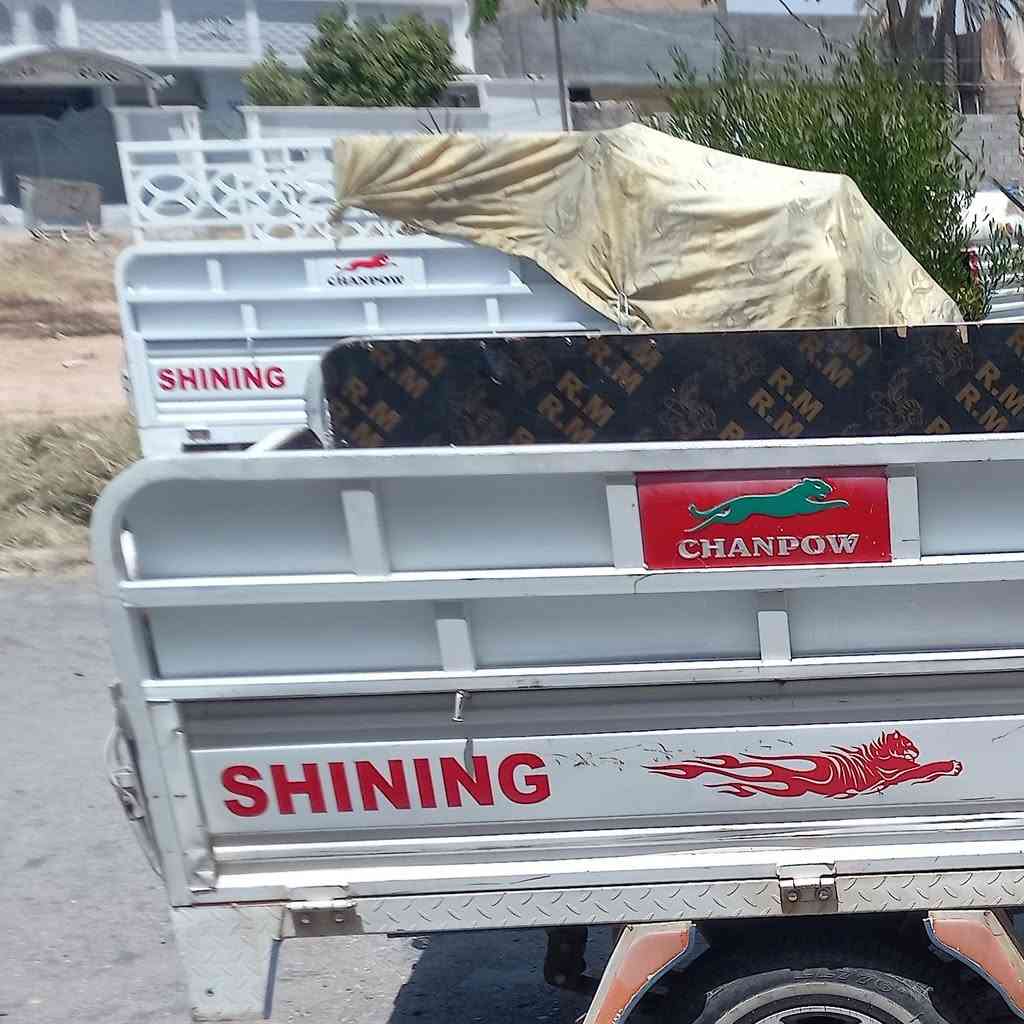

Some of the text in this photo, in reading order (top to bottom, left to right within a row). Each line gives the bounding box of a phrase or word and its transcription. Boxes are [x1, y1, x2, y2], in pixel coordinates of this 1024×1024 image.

[157, 365, 288, 392] SHINING
[677, 533, 860, 561] CHANPOW
[220, 752, 553, 818] SHINING
